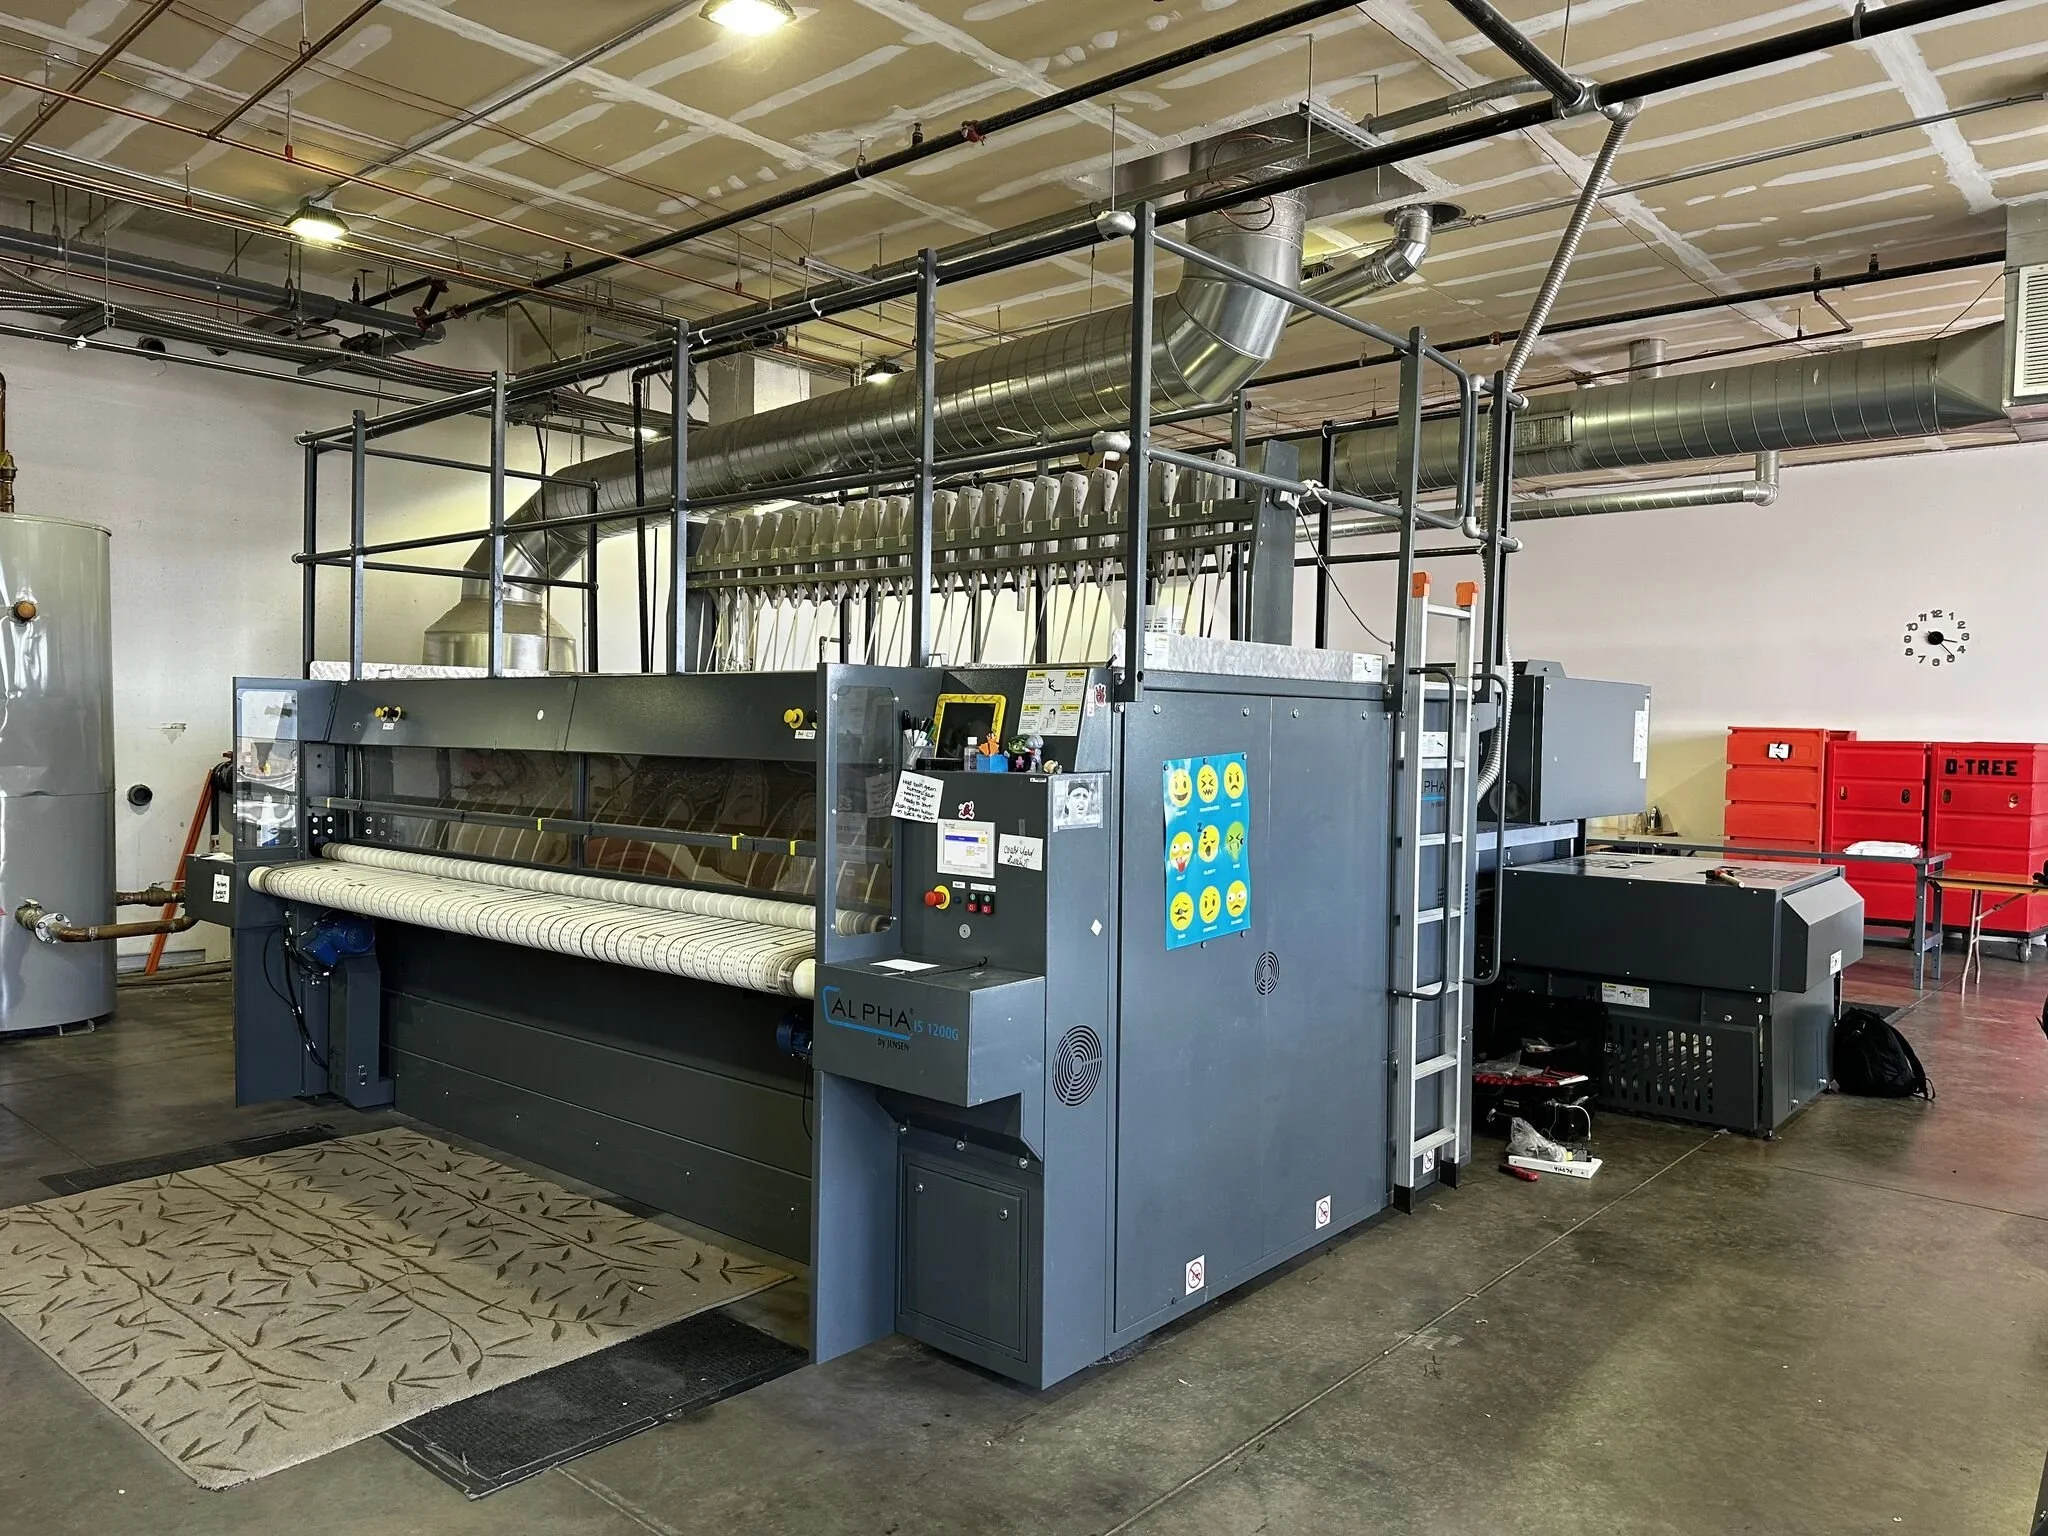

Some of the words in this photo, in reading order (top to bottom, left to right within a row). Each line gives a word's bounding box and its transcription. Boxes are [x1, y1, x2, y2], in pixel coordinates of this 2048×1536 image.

[1918, 613, 1927, 621] 11
[1930, 609, 1943, 618] 12
[1948, 612, 1954, 620] 1
[1906, 622, 1918, 631] 10
[1957, 620, 1966, 629] 2
[1903, 635, 1912, 643] 9
[1961, 632, 1970, 641] 3
[1905, 648, 1914, 656] 8
[1957, 645, 1966, 654] 4
[1918, 655, 1926, 663] 7
[1932, 658, 1940, 667] 6
[1945, 758, 2018, 776] D-TREE
[1422, 780, 1446, 793] PHA
[831, 998, 911, 1031] ALPHA
[927, 1023, 959, 1040] 1200G
[877, 1037, 886, 1048] by
[887, 1040, 909, 1051] JENSEN
